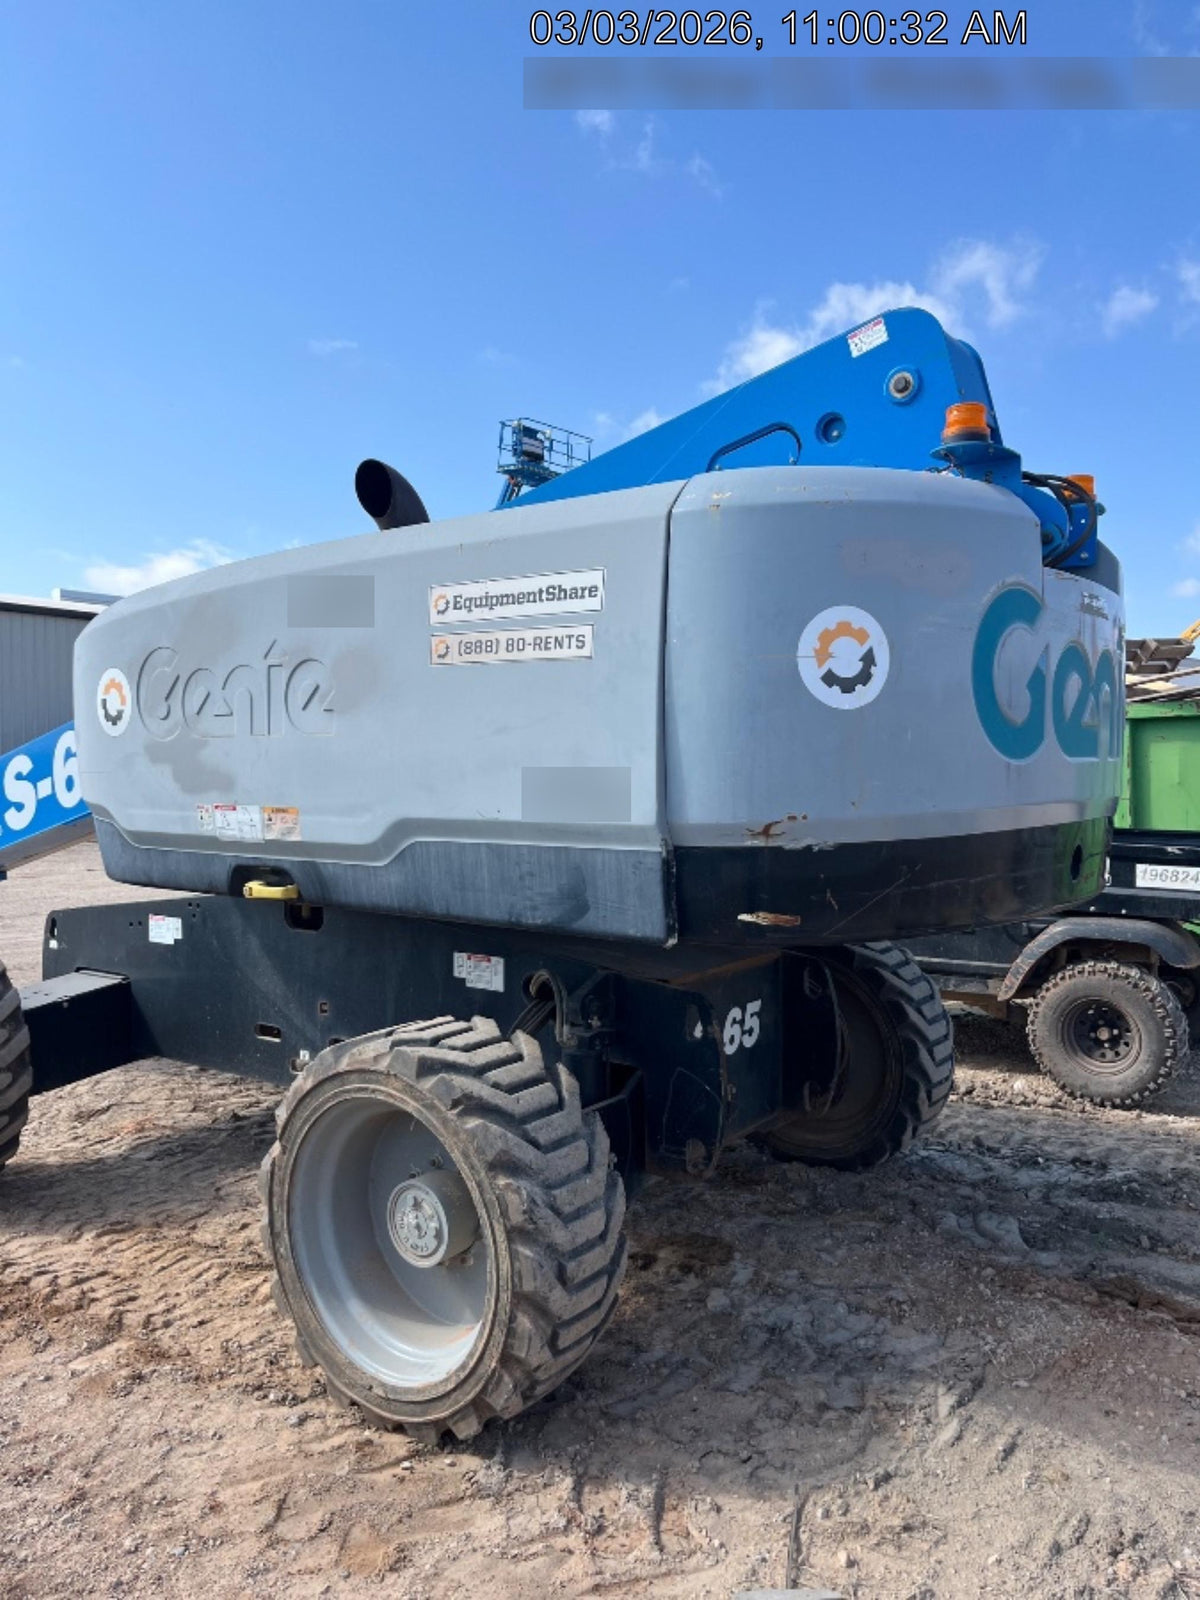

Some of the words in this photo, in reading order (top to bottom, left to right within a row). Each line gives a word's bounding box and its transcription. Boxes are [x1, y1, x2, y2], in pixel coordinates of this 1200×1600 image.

[452, 584, 599, 612] EquipmentShare
[458, 637, 499, 656] (888)
[505, 634, 586, 653] 80-RENTS
[136, 639, 335, 741] Genie
